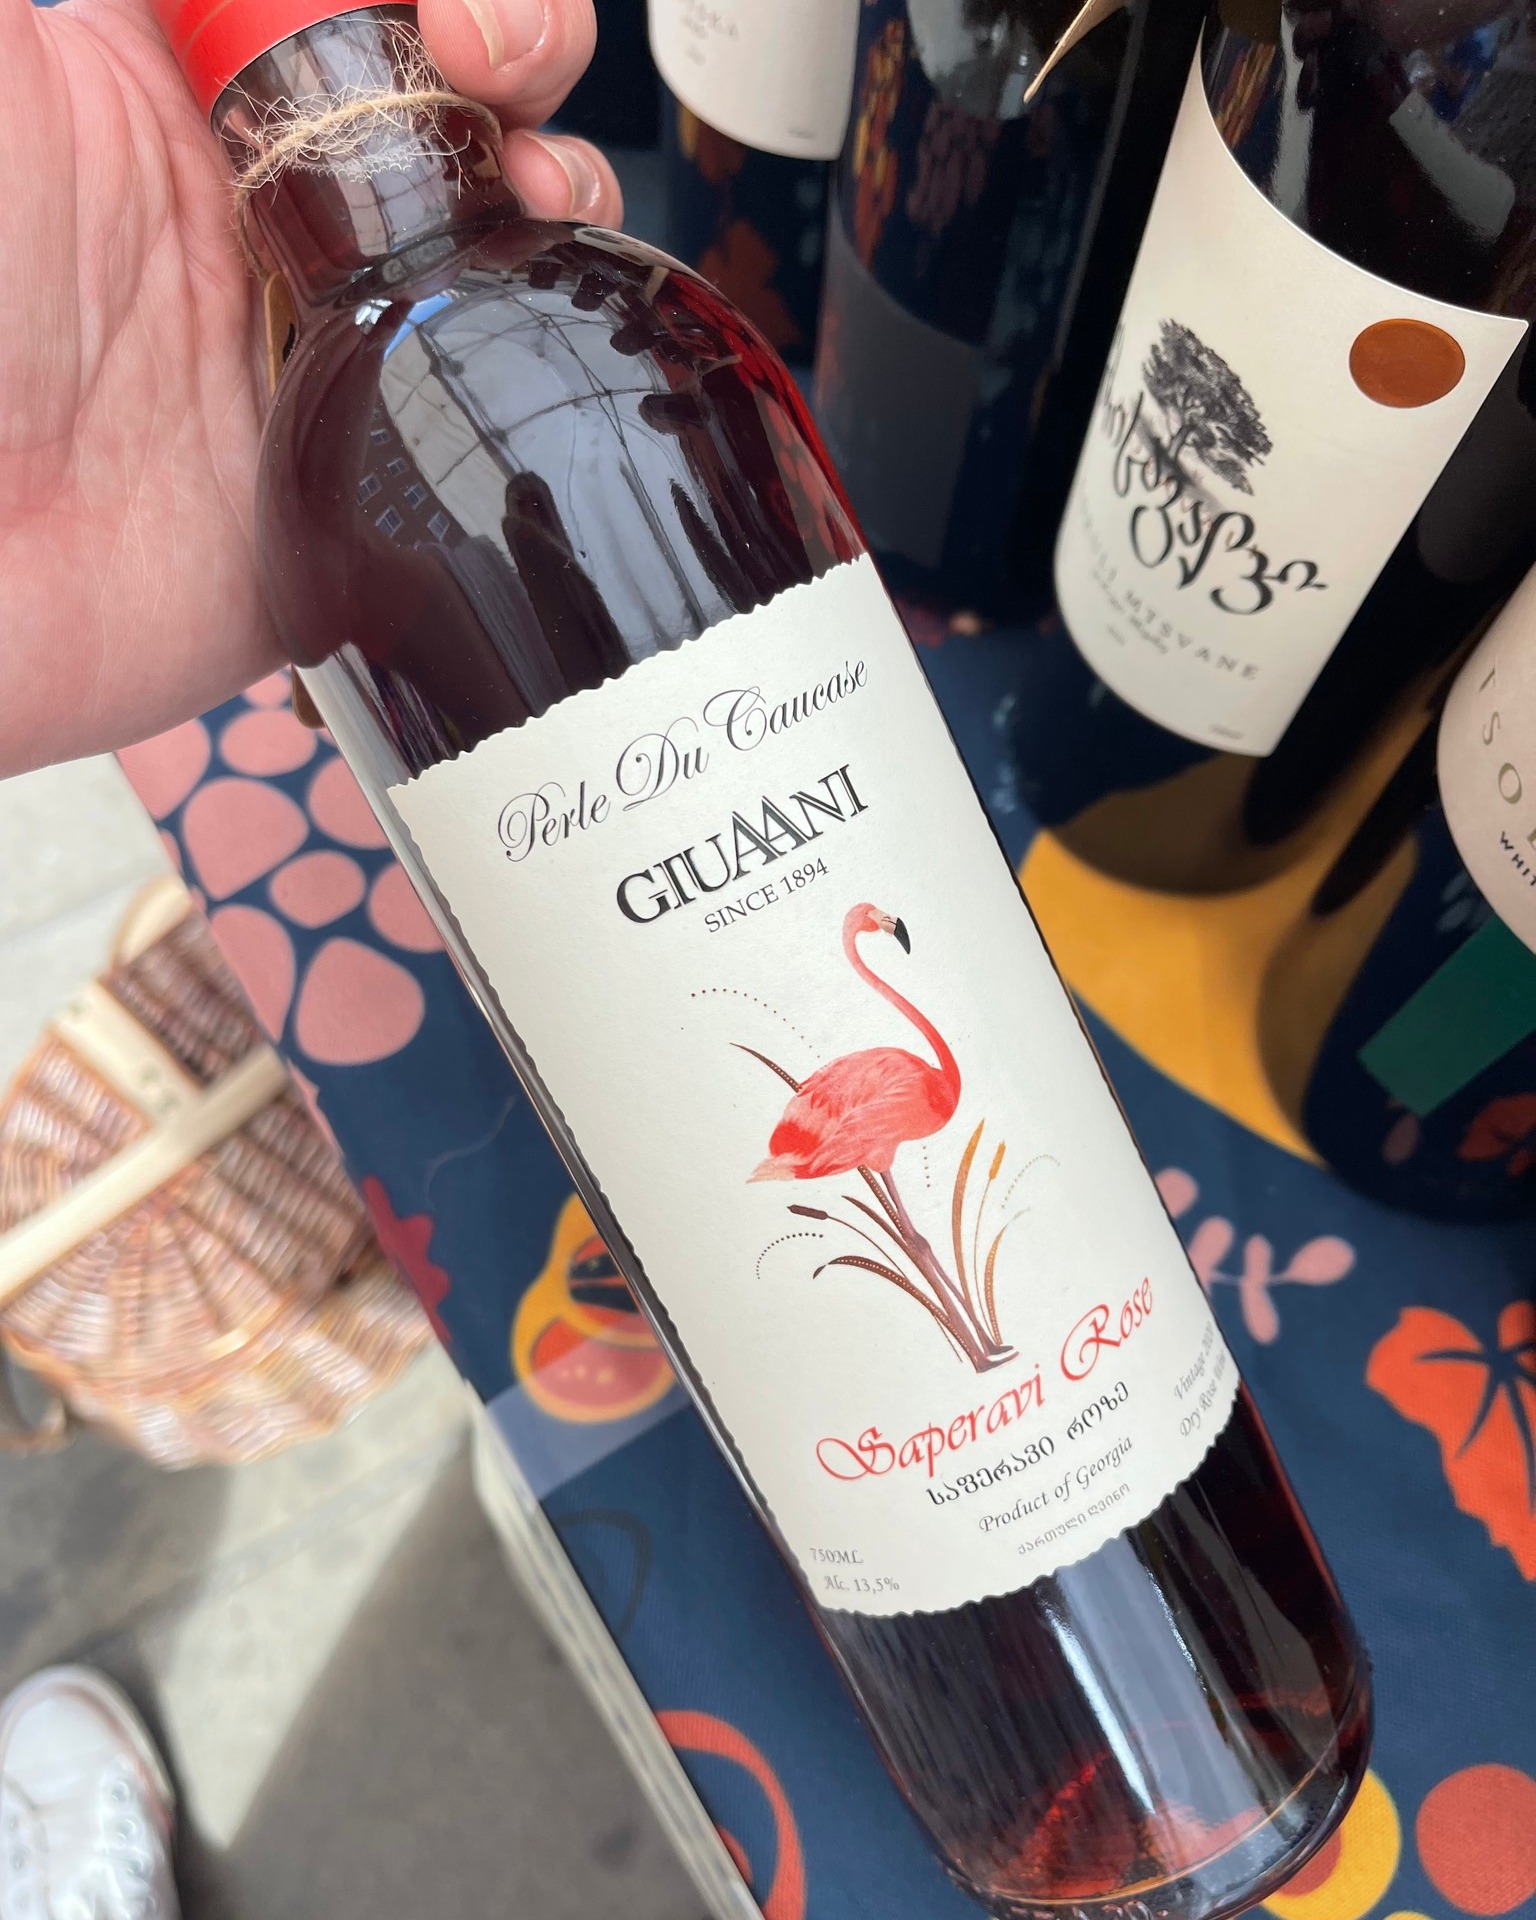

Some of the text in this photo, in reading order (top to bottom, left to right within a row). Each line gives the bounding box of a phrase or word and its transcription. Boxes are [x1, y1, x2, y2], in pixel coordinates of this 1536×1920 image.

[498, 660, 868, 862] Perle Du Caucase
[616, 763, 869, 924] GIUAANI
[704, 857, 830, 934] SINCE 1894
[816, 1363, 1046, 1482] Saperavi
[926, 1381, 1130, 1506] საფერავი როზე
[1180, 1408, 1201, 1437] Dry
[978, 1436, 1133, 1534] Product of Georgia
[809, 1547, 864, 1565] 750ML
[1017, 1513, 1087, 1555] ქართული
[854, 1577, 900, 1595] 13,5%
